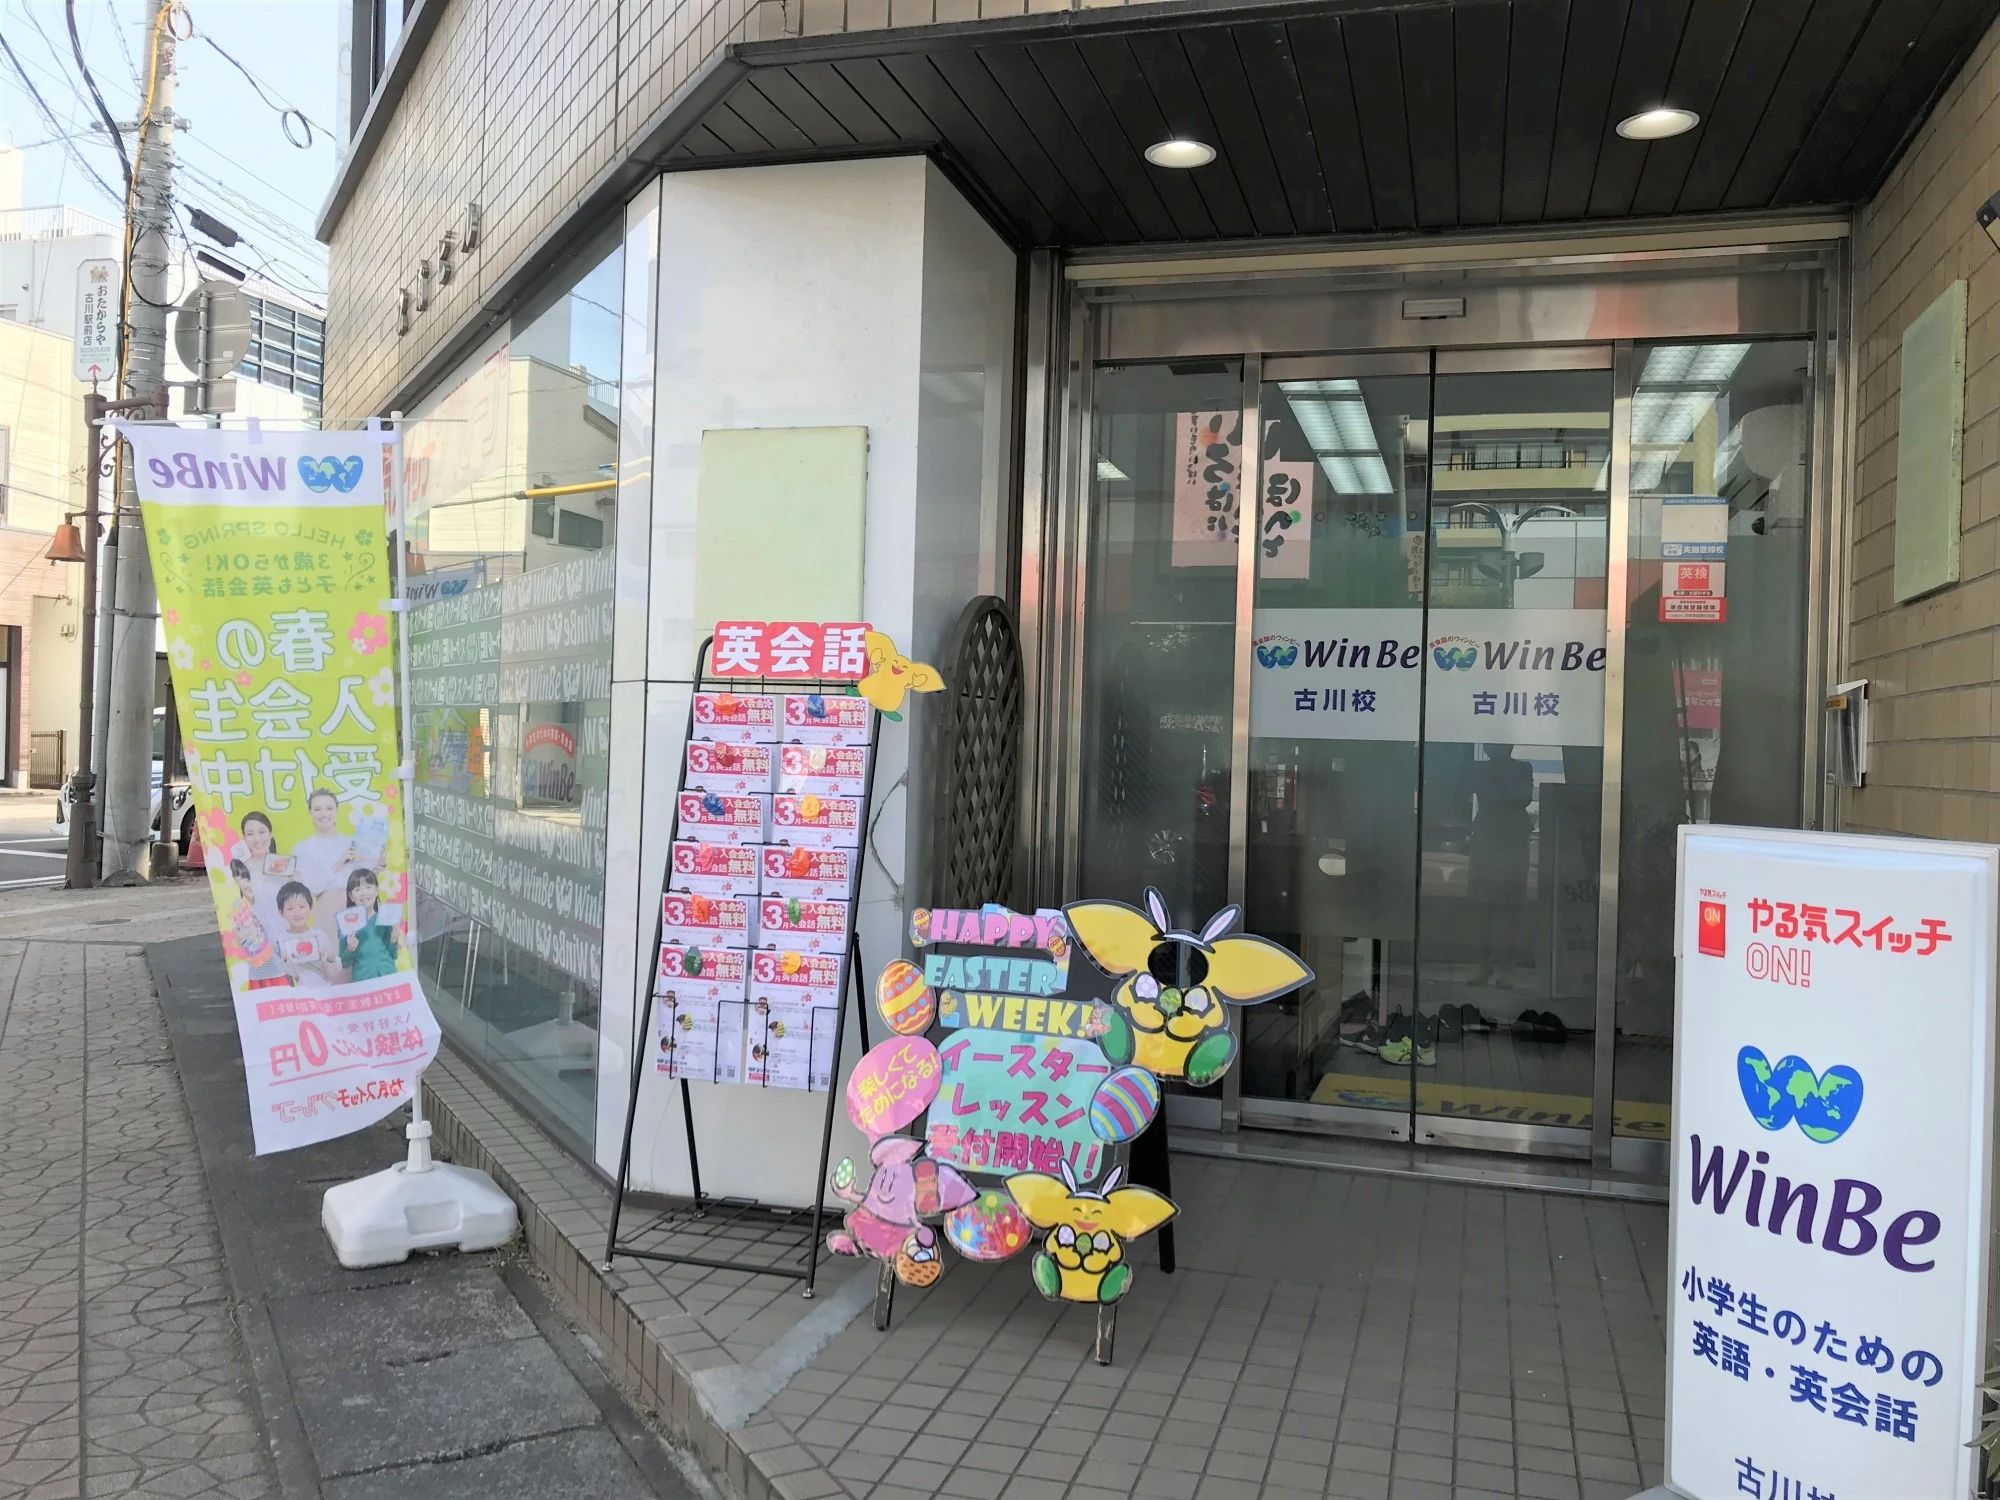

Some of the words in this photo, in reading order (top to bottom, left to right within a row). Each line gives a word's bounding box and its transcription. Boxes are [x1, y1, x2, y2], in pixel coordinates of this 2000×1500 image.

[83, 292, 94, 346] 古川駅前店
[96, 284, 107, 345] おたからや
[1680, 567, 1708, 580] 英検
[716, 626, 866, 673] 英会話
[1294, 688, 1376, 713] 古川校
[1472, 691, 1560, 716] 古川校
[930, 909, 1059, 948] HAPPY
[1704, 907, 1720, 924] ON
[1747, 897, 1953, 956] やる気スイッチ
[924, 955, 1057, 995] EASTER
[1746, 942, 1811, 988] ON!
[965, 994, 1094, 1037] WEEK!
[857, 1043, 917, 1099] 楽しくて
[943, 1039, 1109, 1081] イースター
[952, 1083, 1085, 1128] レッスン
[1690, 1133, 1941, 1273] WinBe
[1682, 1265, 1944, 1388] 小学生のための
[1692, 1320, 1919, 1443] 英語・英会話
